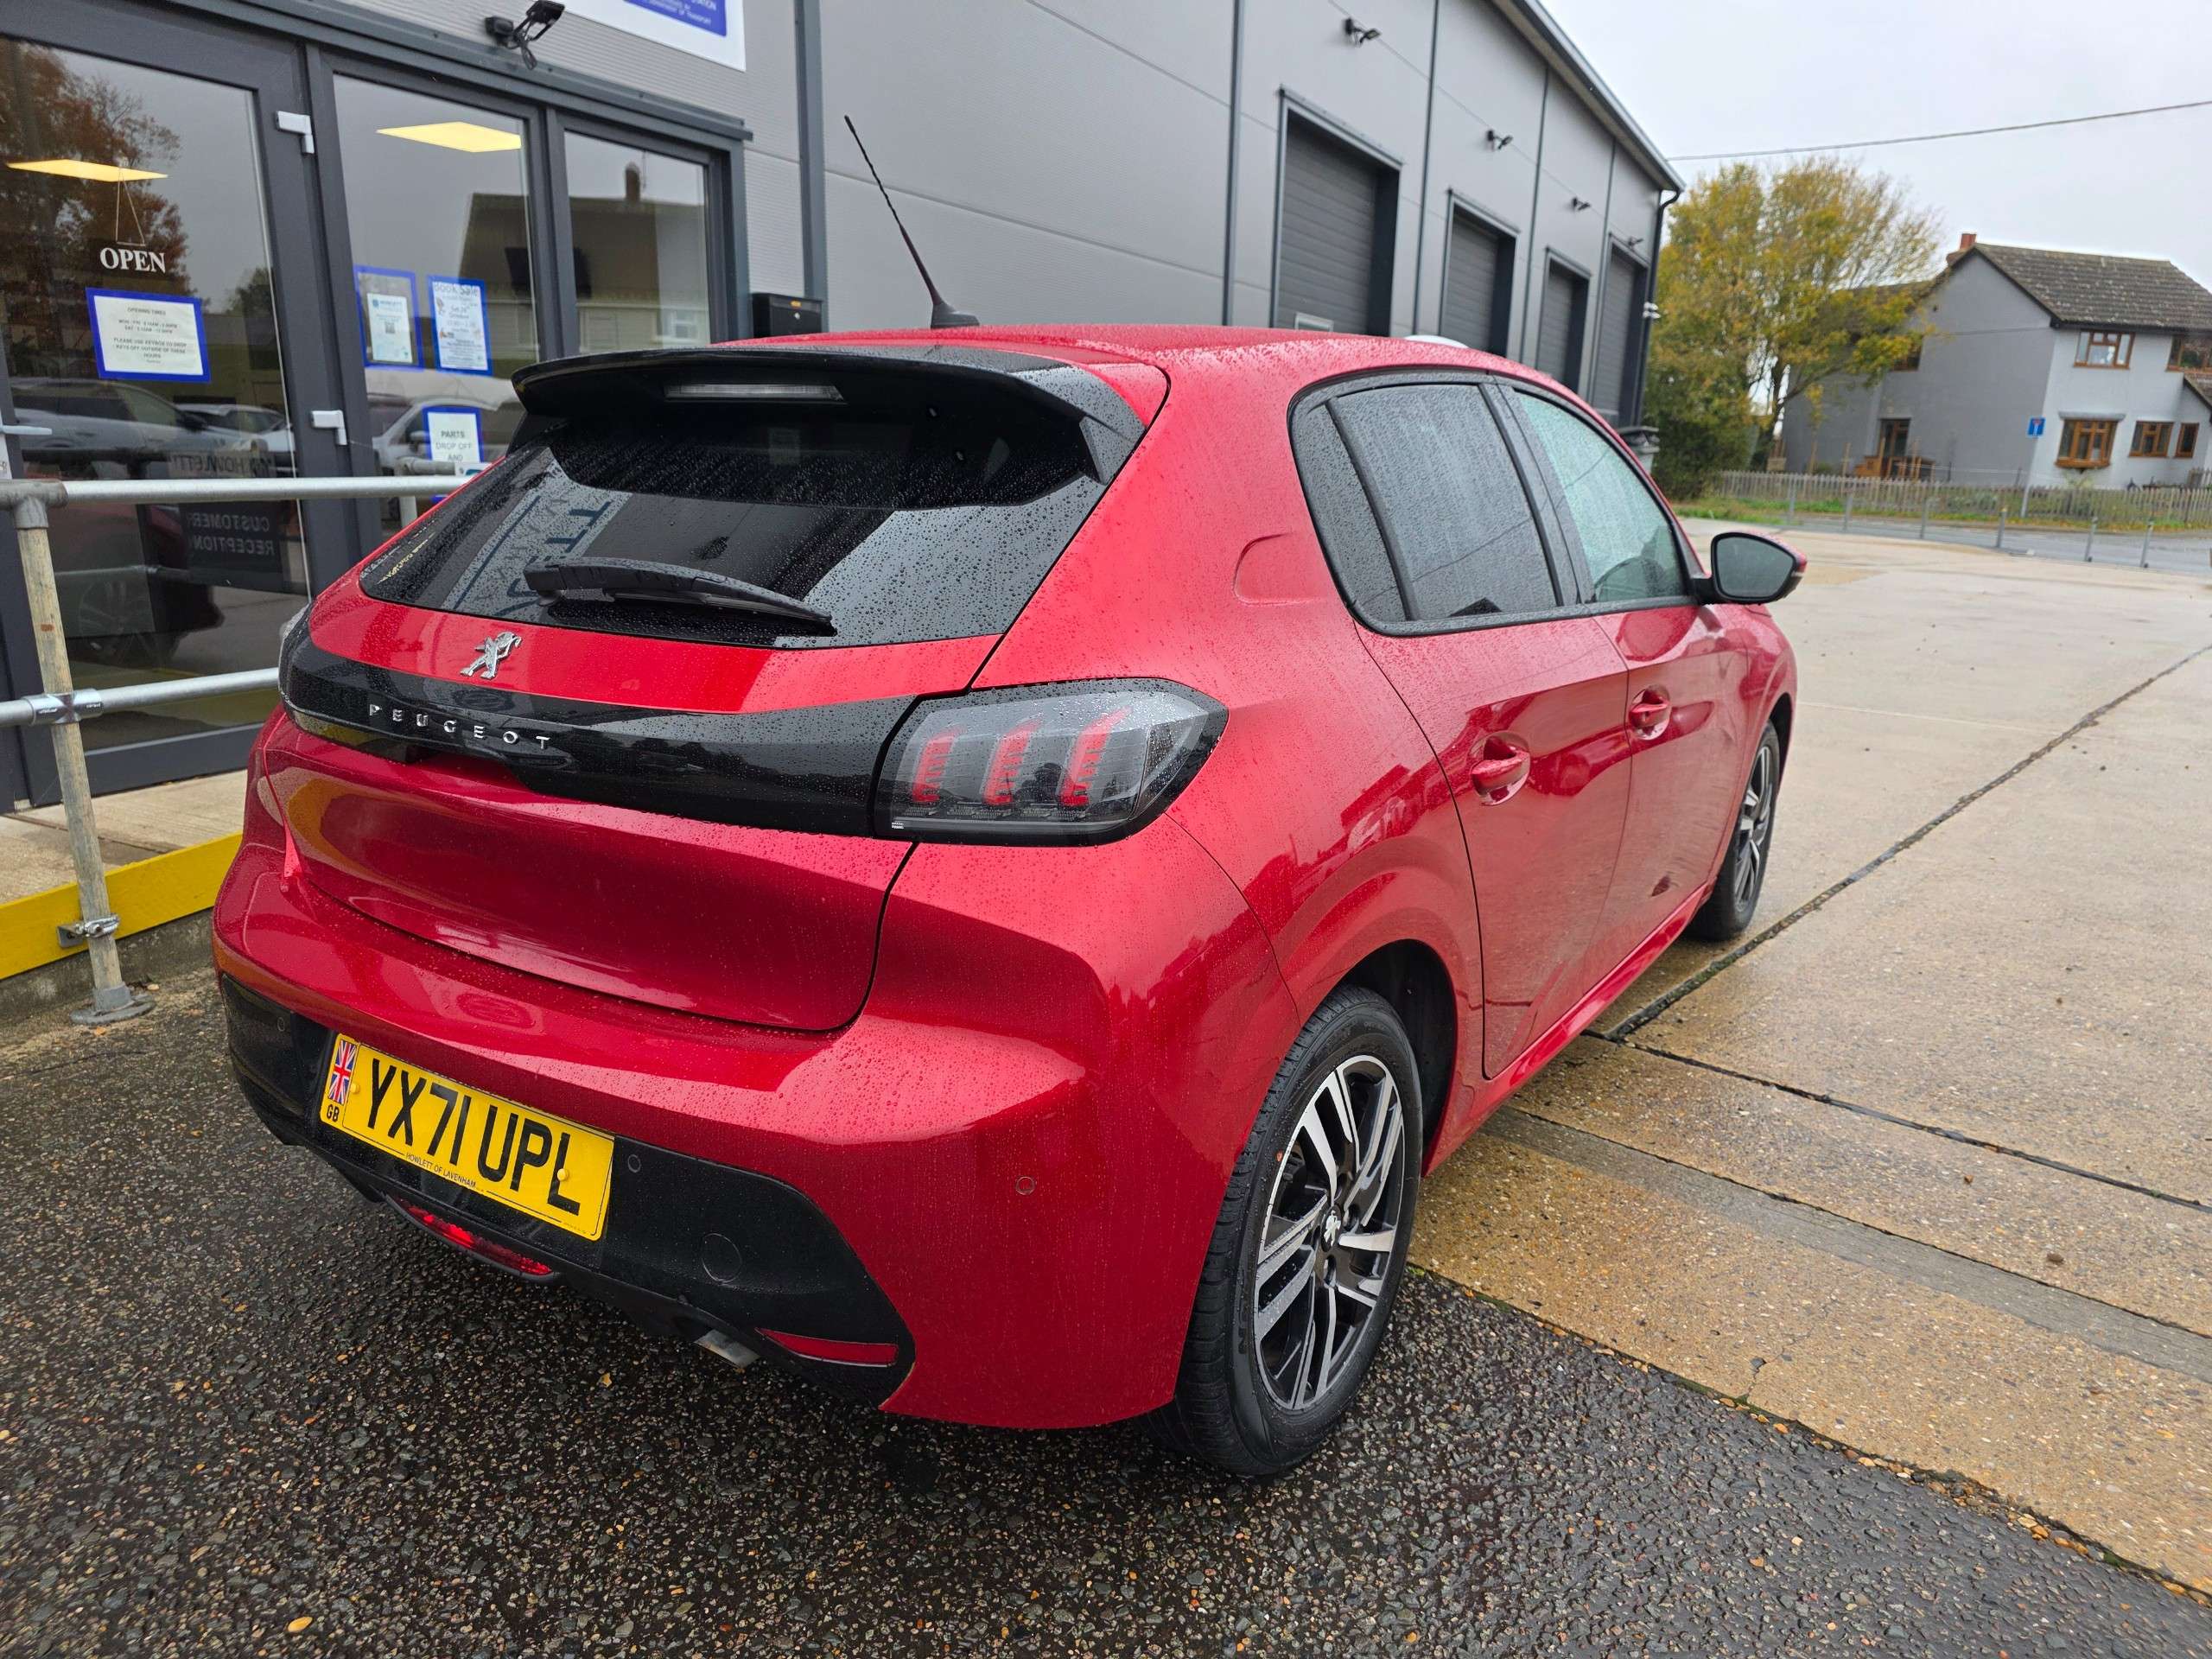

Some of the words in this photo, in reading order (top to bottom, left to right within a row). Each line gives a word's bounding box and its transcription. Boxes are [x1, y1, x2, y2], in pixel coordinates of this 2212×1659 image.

[100, 247, 166, 273] OPEN
[369, 703, 550, 751] PEUGEOT
[326, 1103, 340, 1122] GB
[367, 1058, 473, 1166] YX71
[477, 1105, 581, 1217] UPL
[405, 1152, 433, 1169] HOWLETT
[443, 1169, 476, 1188] LAVENHAM
